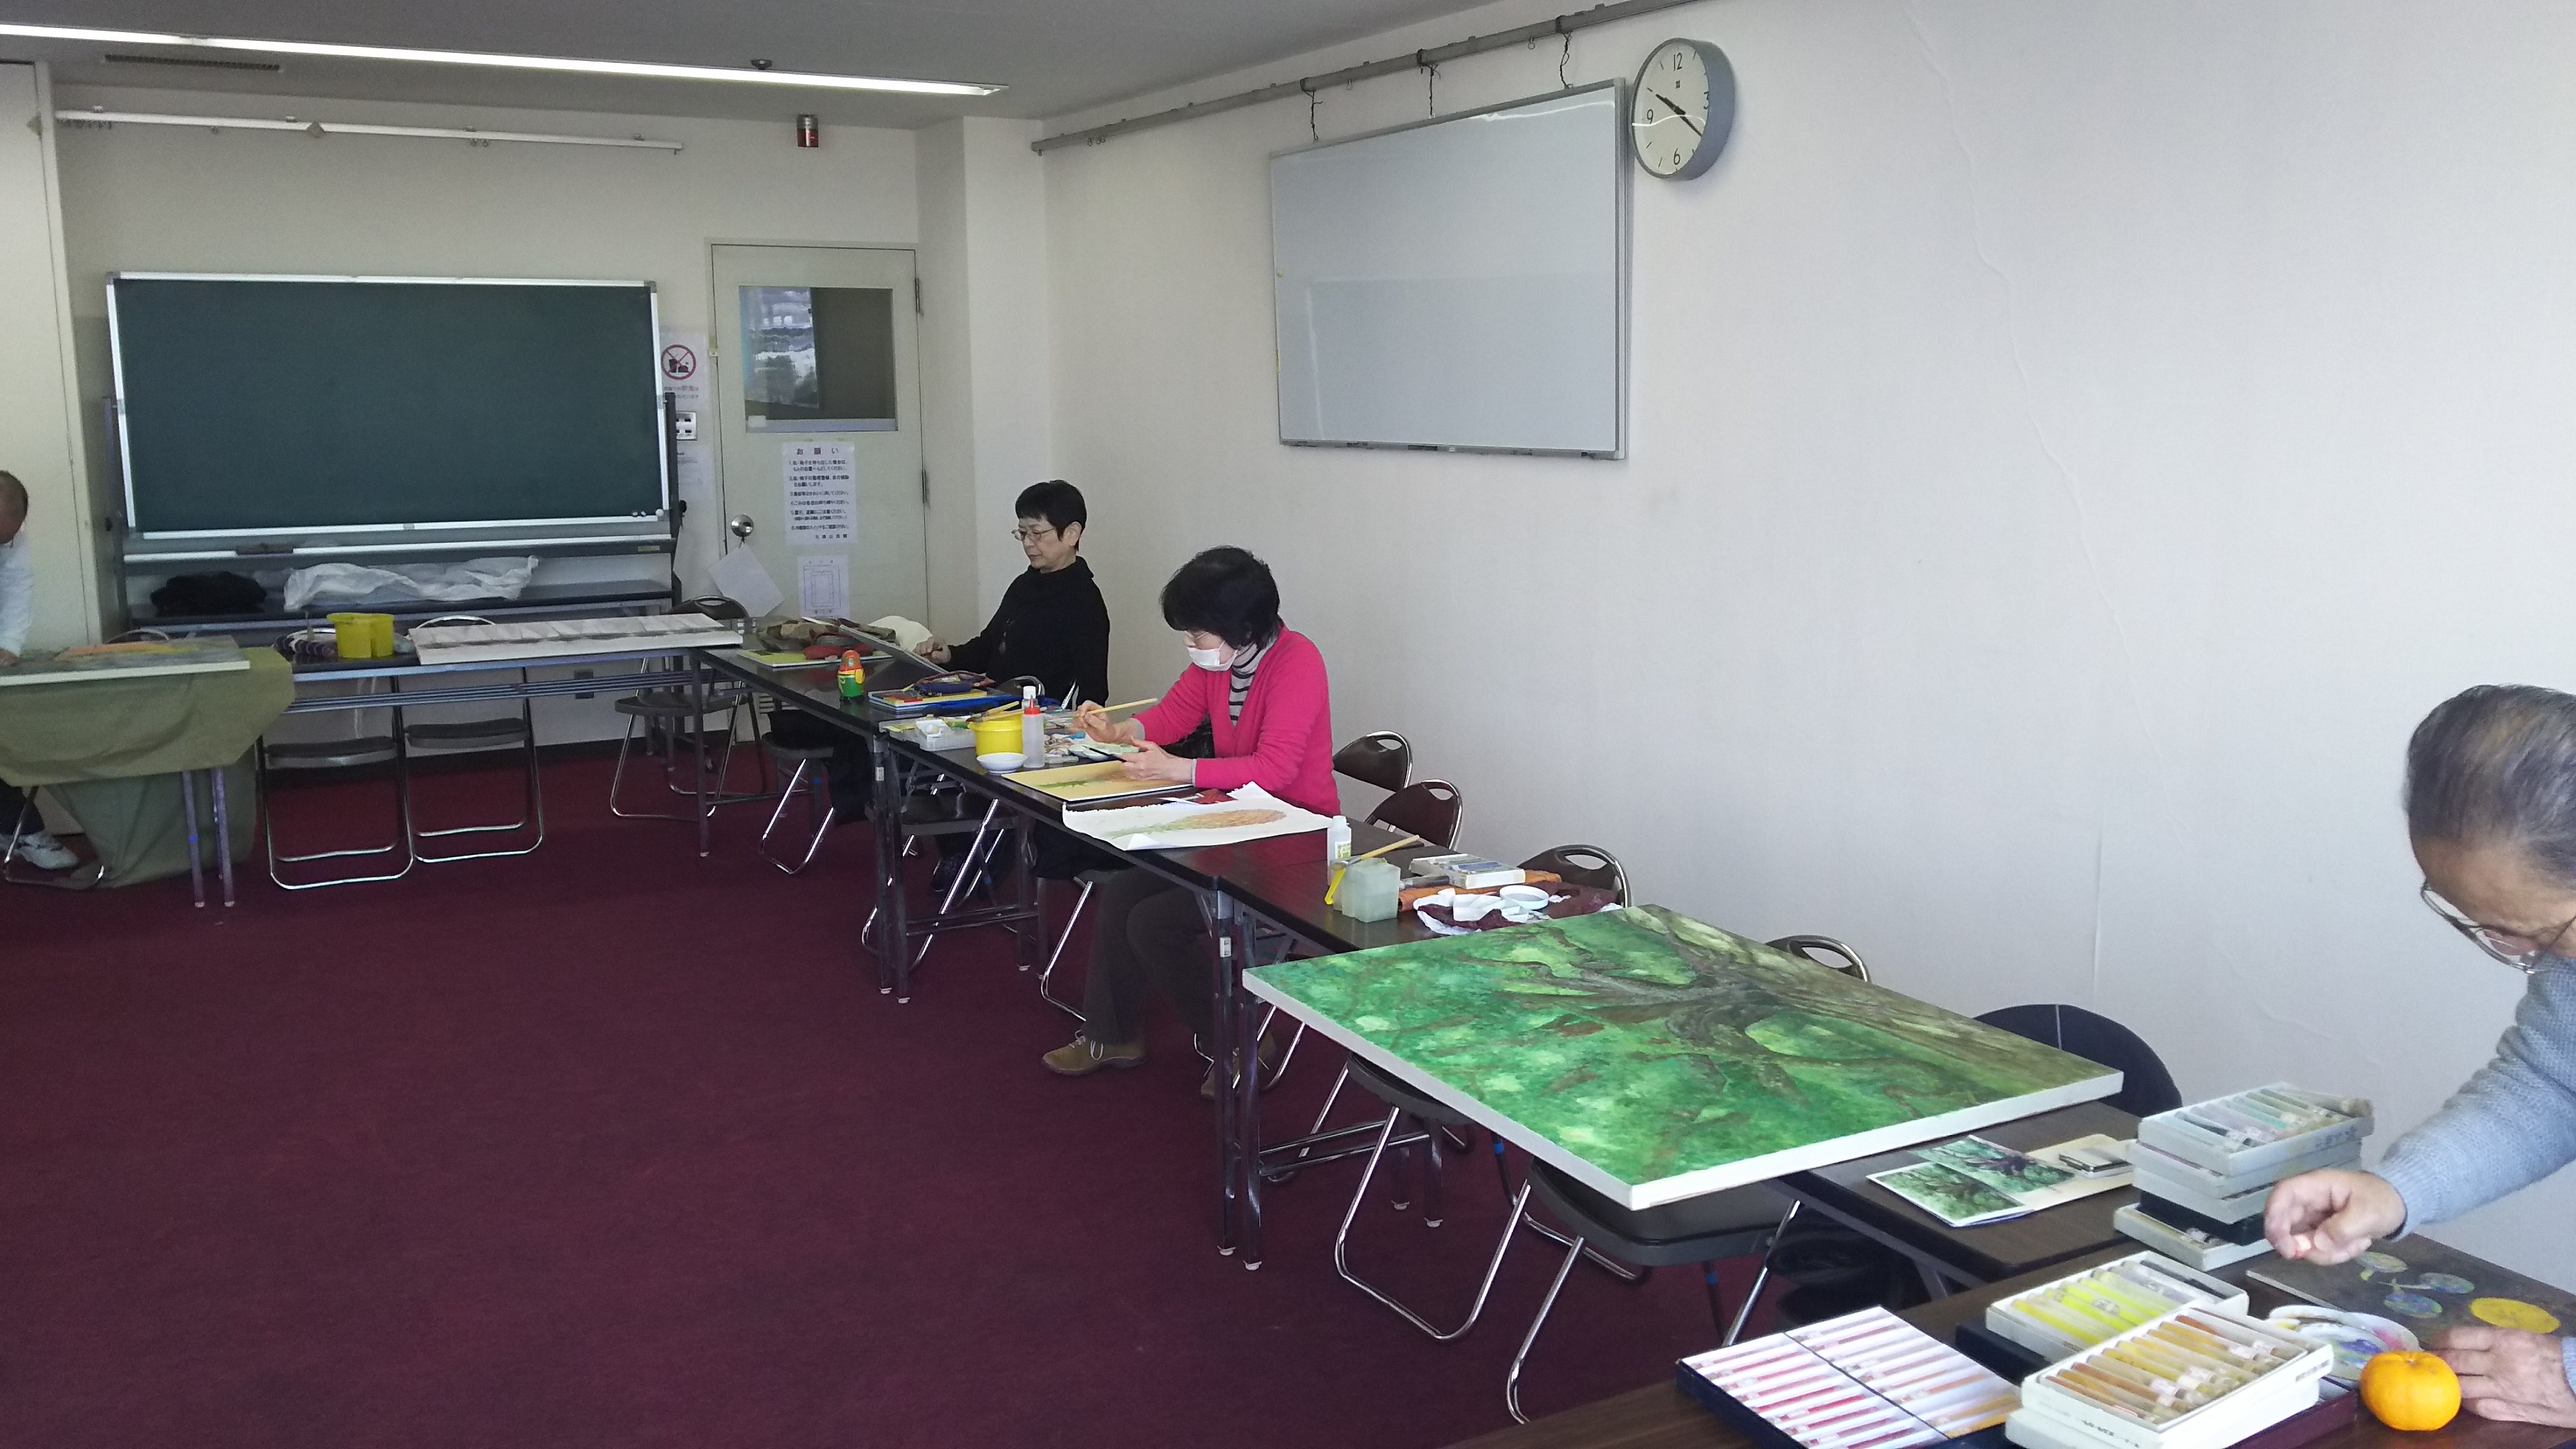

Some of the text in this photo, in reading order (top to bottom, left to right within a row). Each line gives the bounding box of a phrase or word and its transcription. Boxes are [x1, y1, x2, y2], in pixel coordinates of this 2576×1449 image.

[1673, 52, 1683, 71] 12
[1703, 91, 1709, 110] 3
[1646, 109, 1654, 125] 9
[1672, 148, 1681, 166] 6
[796, 447, 839, 455] お願い
